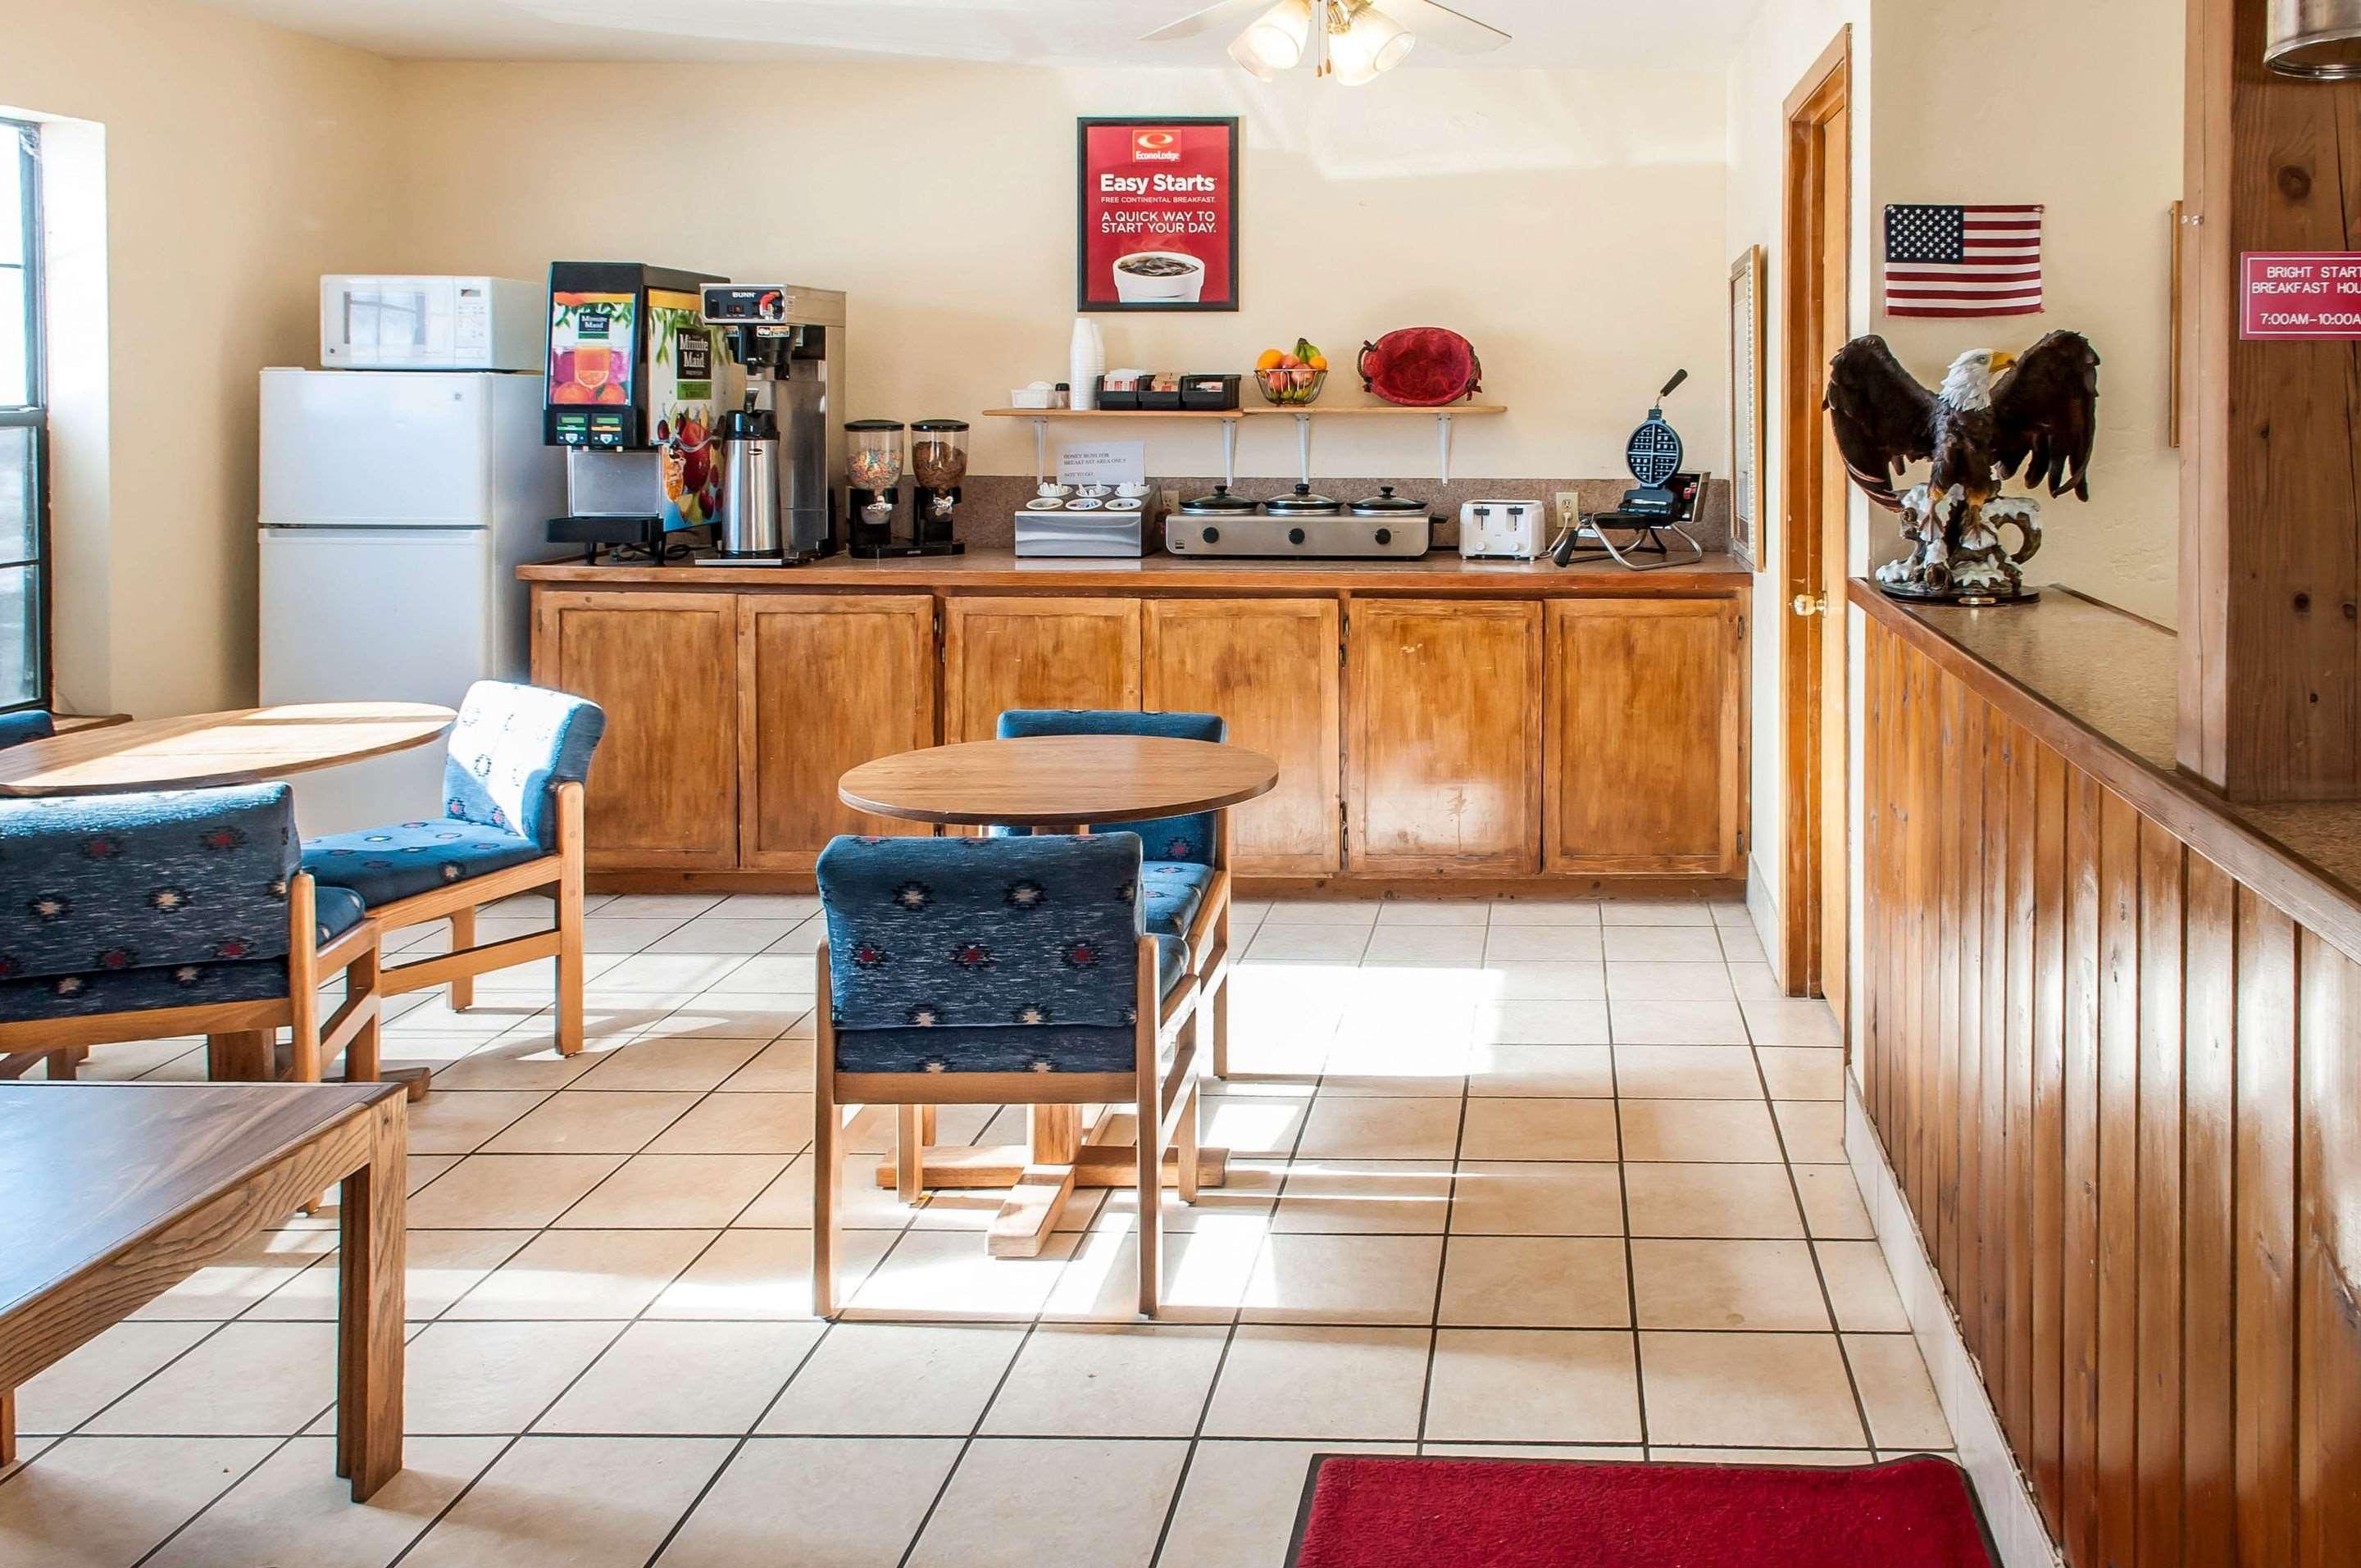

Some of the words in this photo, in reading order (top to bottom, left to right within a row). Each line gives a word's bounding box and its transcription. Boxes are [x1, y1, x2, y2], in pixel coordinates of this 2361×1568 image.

[1100, 174, 1149, 195] Easy
[1153, 173, 1216, 192] Starts
[1101, 211, 1112, 222] A
[1115, 211, 1159, 222] QUICK
[1162, 211, 1193, 222] WAY
[1197, 211, 1216, 222] TO
[1101, 222, 1144, 234] START
[1148, 222, 1185, 234] YOUR
[1188, 222, 1217, 234] DAY.
[2267, 266, 2313, 279] BRIGHT
[2251, 282, 2330, 294] BREAKFAST
[680, 334, 708, 352] Minute
[684, 352, 704, 368] Maid
